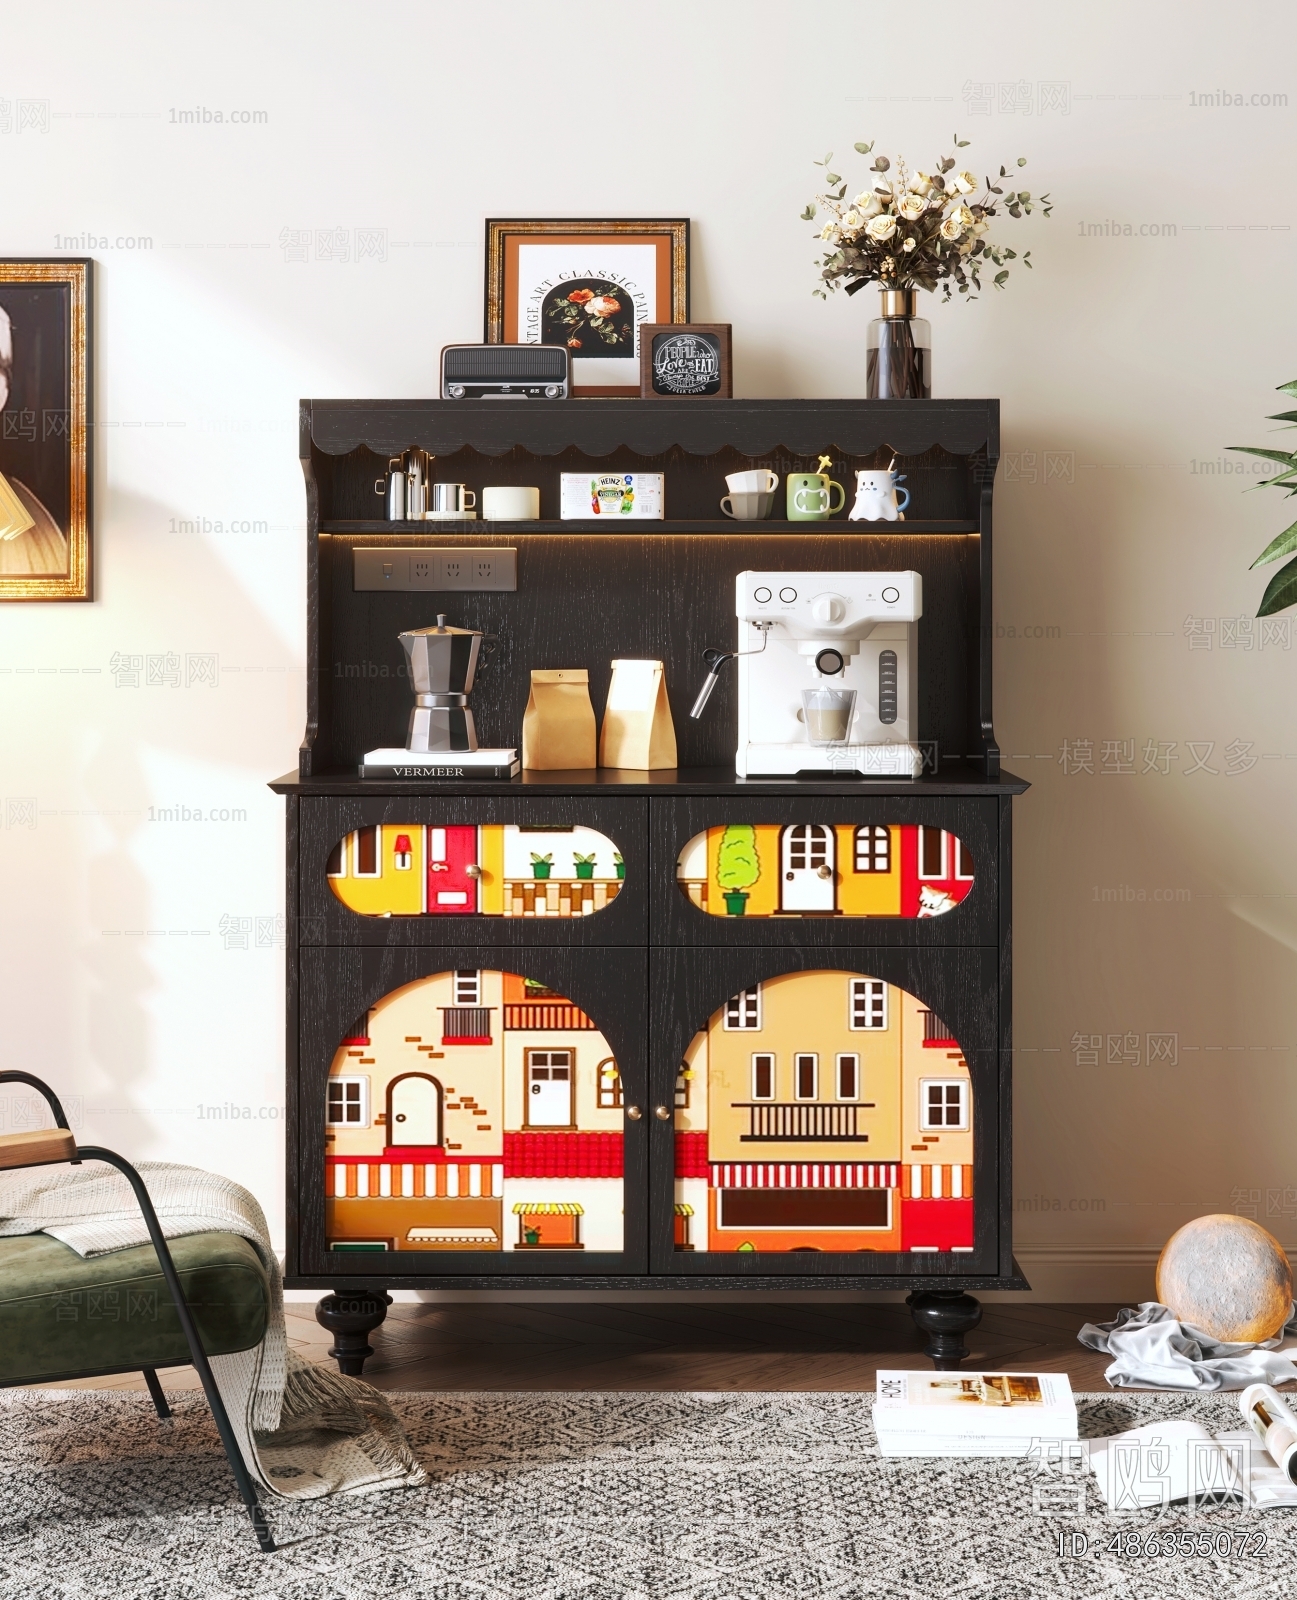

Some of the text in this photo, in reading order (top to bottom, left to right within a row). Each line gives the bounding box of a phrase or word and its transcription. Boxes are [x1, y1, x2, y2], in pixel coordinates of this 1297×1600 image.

[530, 278, 554, 304] ART
[558, 269, 637, 291] CLASSIC
[664, 346, 697, 359] PEOPLE
[695, 358, 714, 373] EAT
[600, 477, 621, 486] HEINZ
[392, 767, 464, 777] VERMEER
[881, 1380, 902, 1399] HOME
